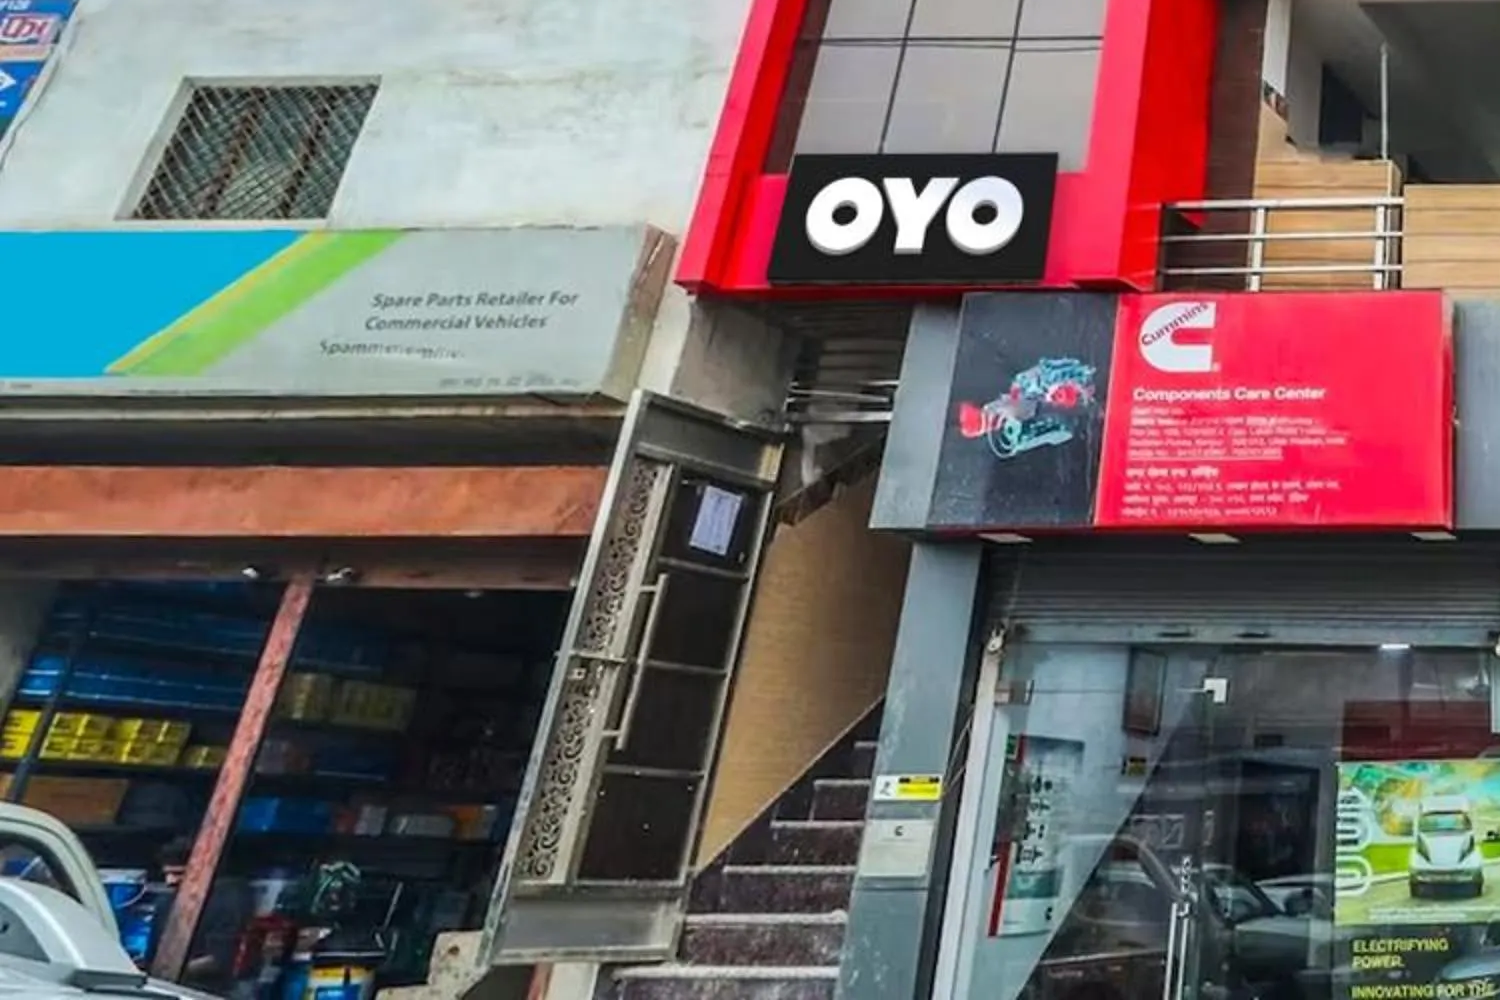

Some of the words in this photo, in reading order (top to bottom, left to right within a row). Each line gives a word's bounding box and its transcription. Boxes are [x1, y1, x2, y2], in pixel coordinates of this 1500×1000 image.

[805, 176, 1024, 255] OYO
[371, 293, 423, 310] Spare
[426, 293, 472, 307] Parts
[475, 291, 545, 307] Retailer
[549, 290, 580, 306] For
[364, 316, 471, 331] Commercial
[474, 315, 549, 330] Vehicles
[1132, 387, 1231, 403] Components
[1233, 387, 1271, 401] Care
[1274, 386, 1327, 400] Center
[1352, 937, 1450, 953] ELECTRIFYING
[1352, 983, 1434, 1000] INNOVATING
[1436, 982, 1466, 998] FOR
[1467, 981, 1496, 998] THE
